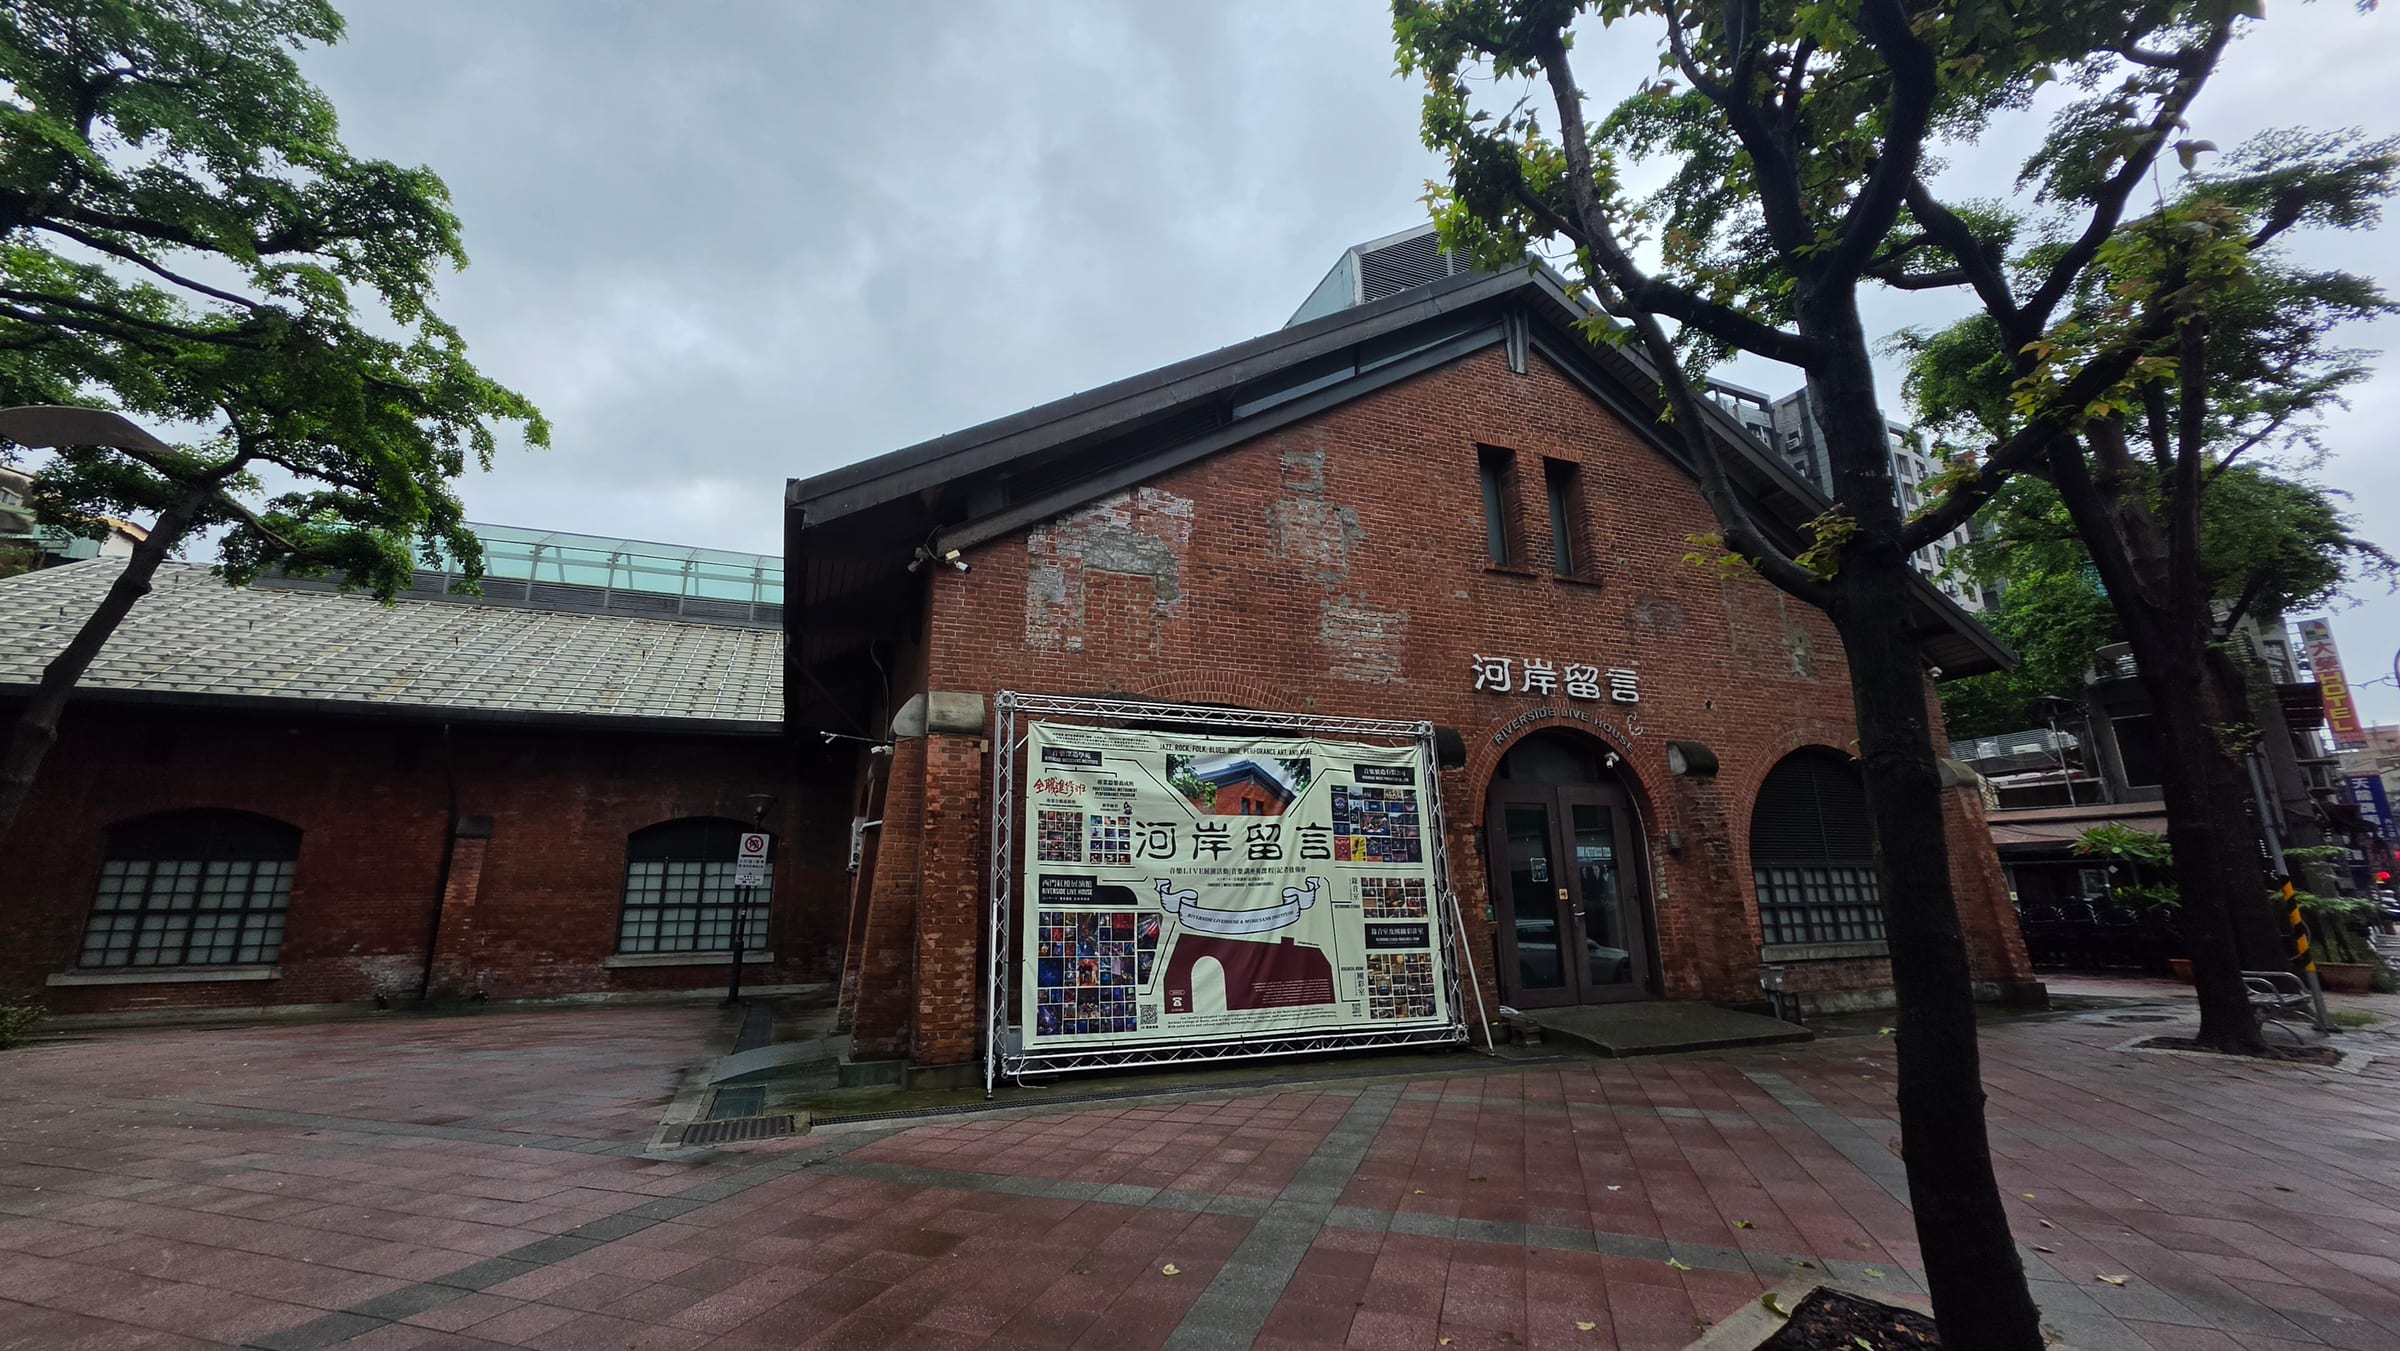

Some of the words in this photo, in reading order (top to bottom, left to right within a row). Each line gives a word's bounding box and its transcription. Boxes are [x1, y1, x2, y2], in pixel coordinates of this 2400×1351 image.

[1471, 653, 1640, 702] 河岸留言
[2319, 672, 2353, 732] HOTEL
[1494, 706, 1556, 744] RIVERSIDE
[1560, 707, 1589, 722] LIVE
[1594, 718, 1634, 753] HOUSE
[1136, 820, 1332, 861] 河岸留言
[1042, 887, 1066, 895] RIVERSIDE
[1078, 888, 1093, 896] HOUSE
